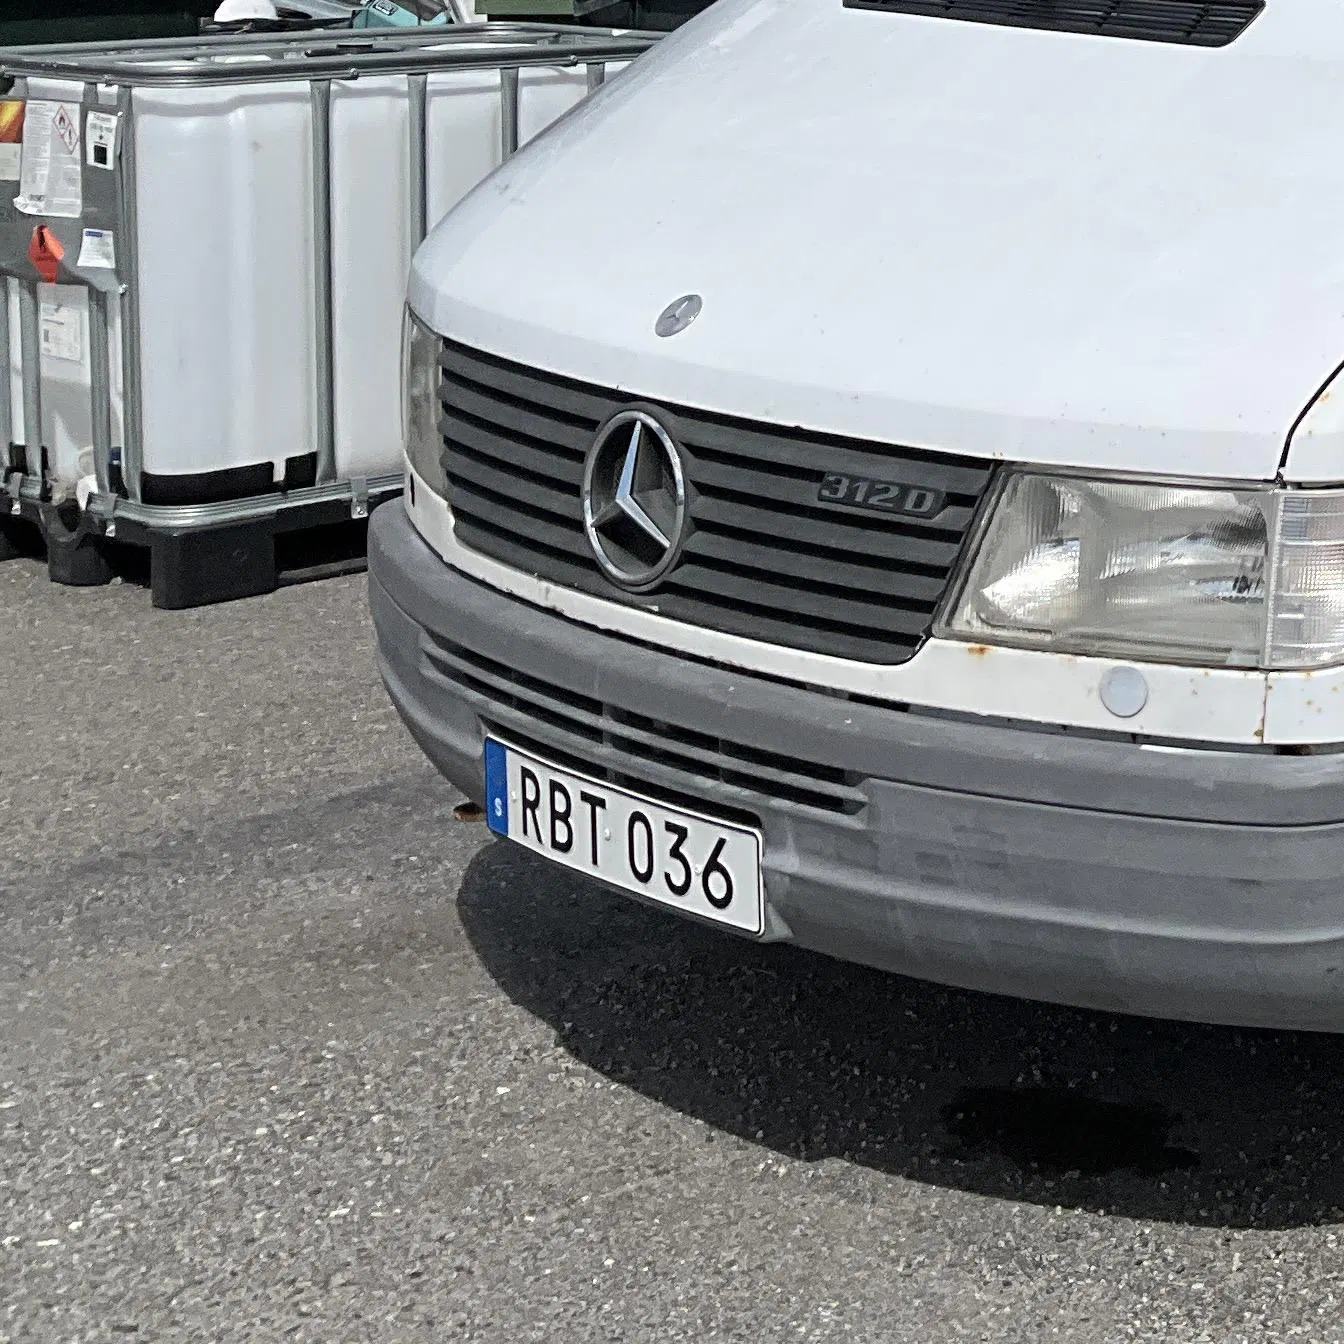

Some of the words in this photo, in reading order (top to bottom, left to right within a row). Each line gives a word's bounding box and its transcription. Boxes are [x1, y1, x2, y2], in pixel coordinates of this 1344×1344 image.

[494, 797, 503, 817] S
[520, 765, 606, 866] RBT
[628, 810, 733, 909] 036
